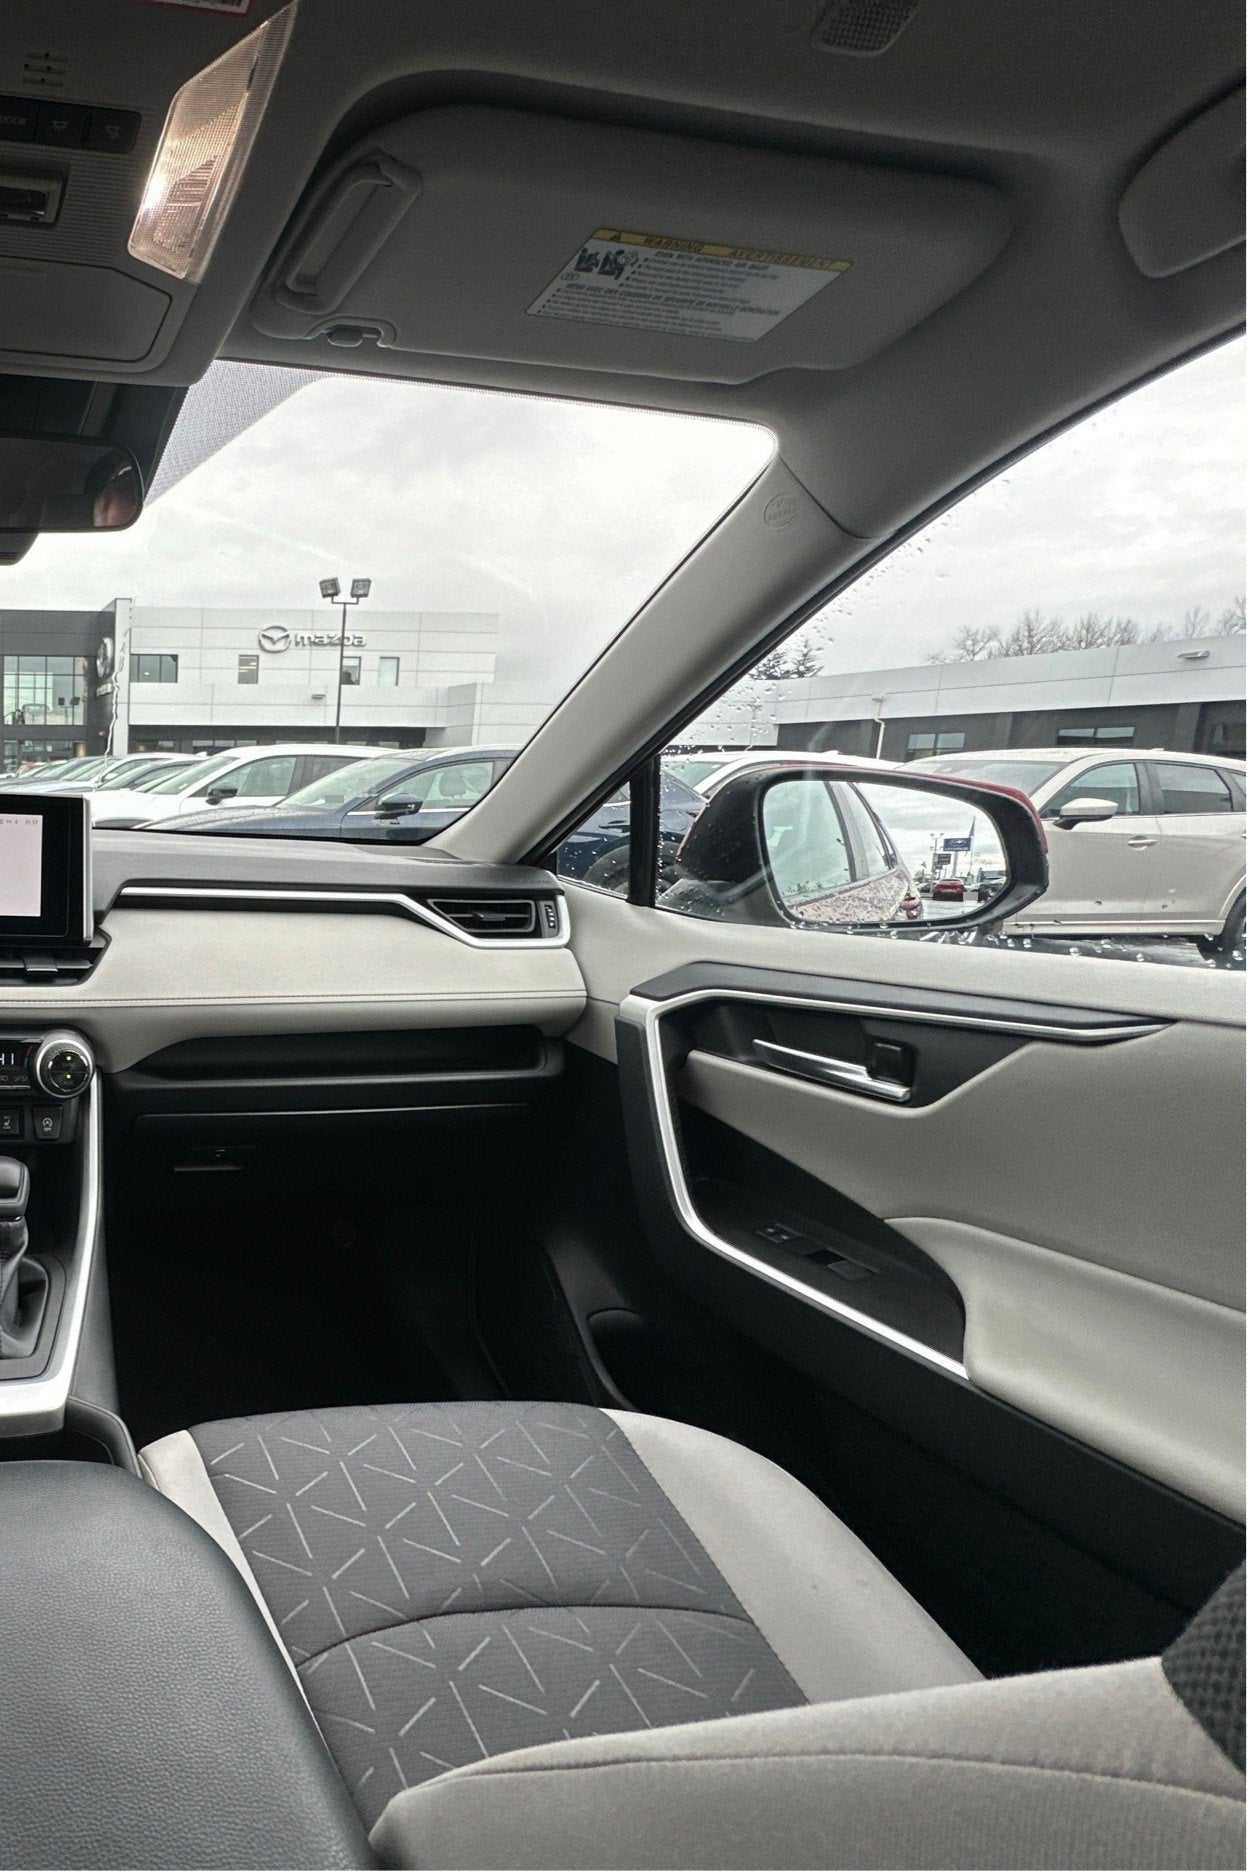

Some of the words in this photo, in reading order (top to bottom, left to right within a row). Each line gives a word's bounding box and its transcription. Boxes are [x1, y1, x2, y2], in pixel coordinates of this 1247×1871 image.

[643, 238, 704, 251] WARNING
[730, 249, 834, 268] AVERTISSEMENT
[293, 632, 367, 648] mazda
